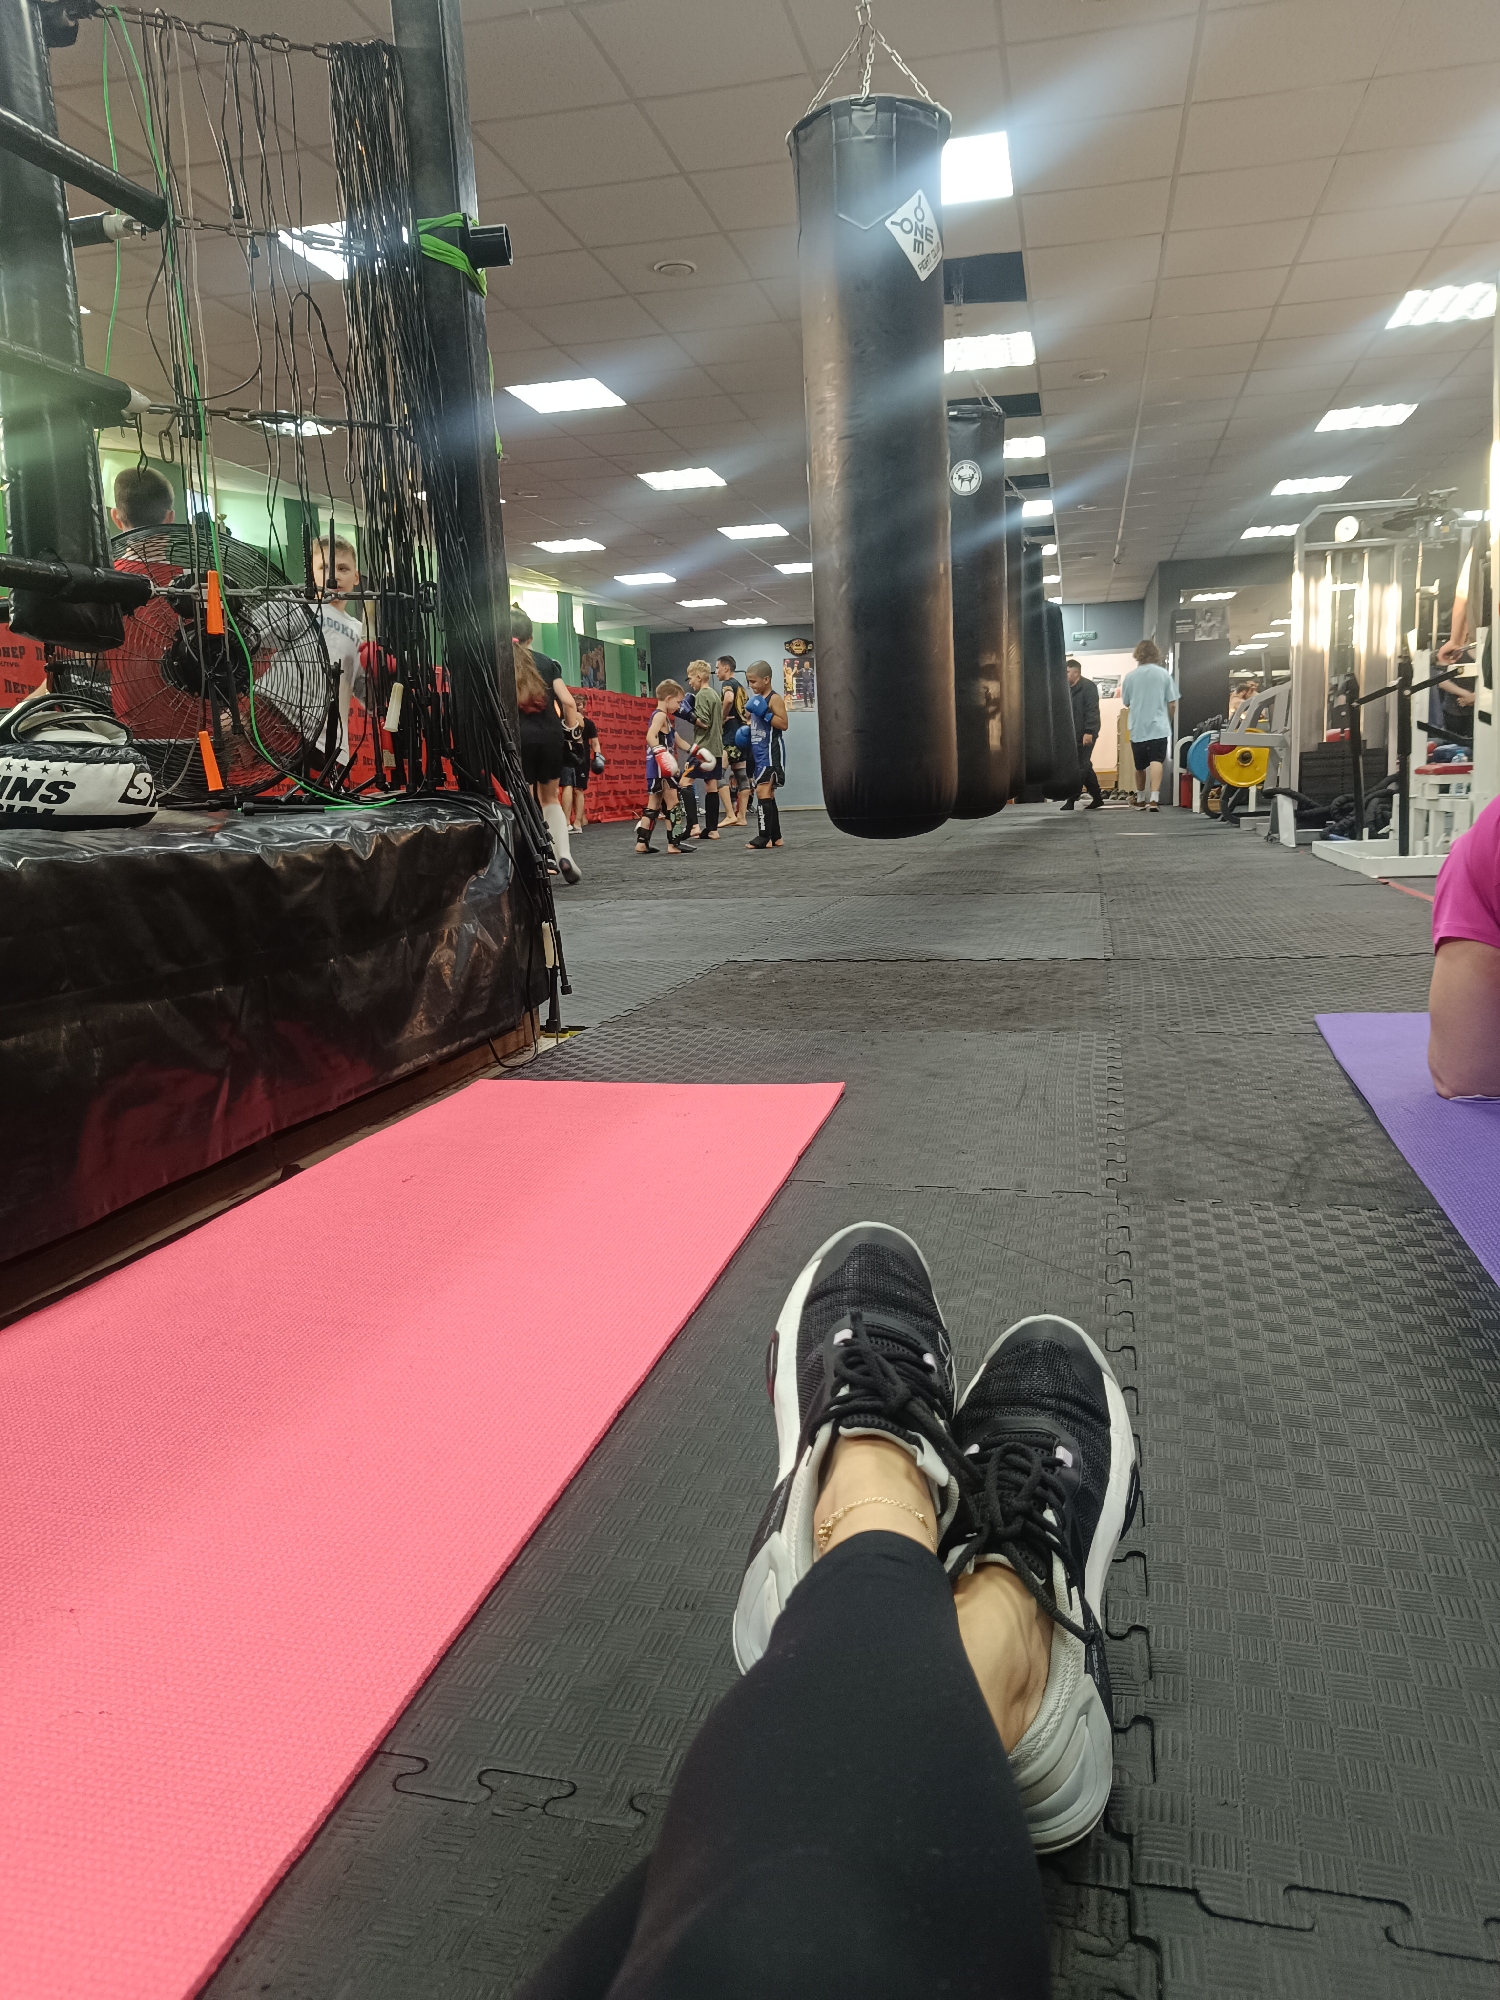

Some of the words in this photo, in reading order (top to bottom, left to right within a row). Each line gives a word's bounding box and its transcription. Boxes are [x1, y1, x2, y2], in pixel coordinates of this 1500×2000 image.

[0, 645, 26, 659] НЕР
[4, 678, 40, 695] ЛЕГИ
[0, 775, 77, 805] INS
